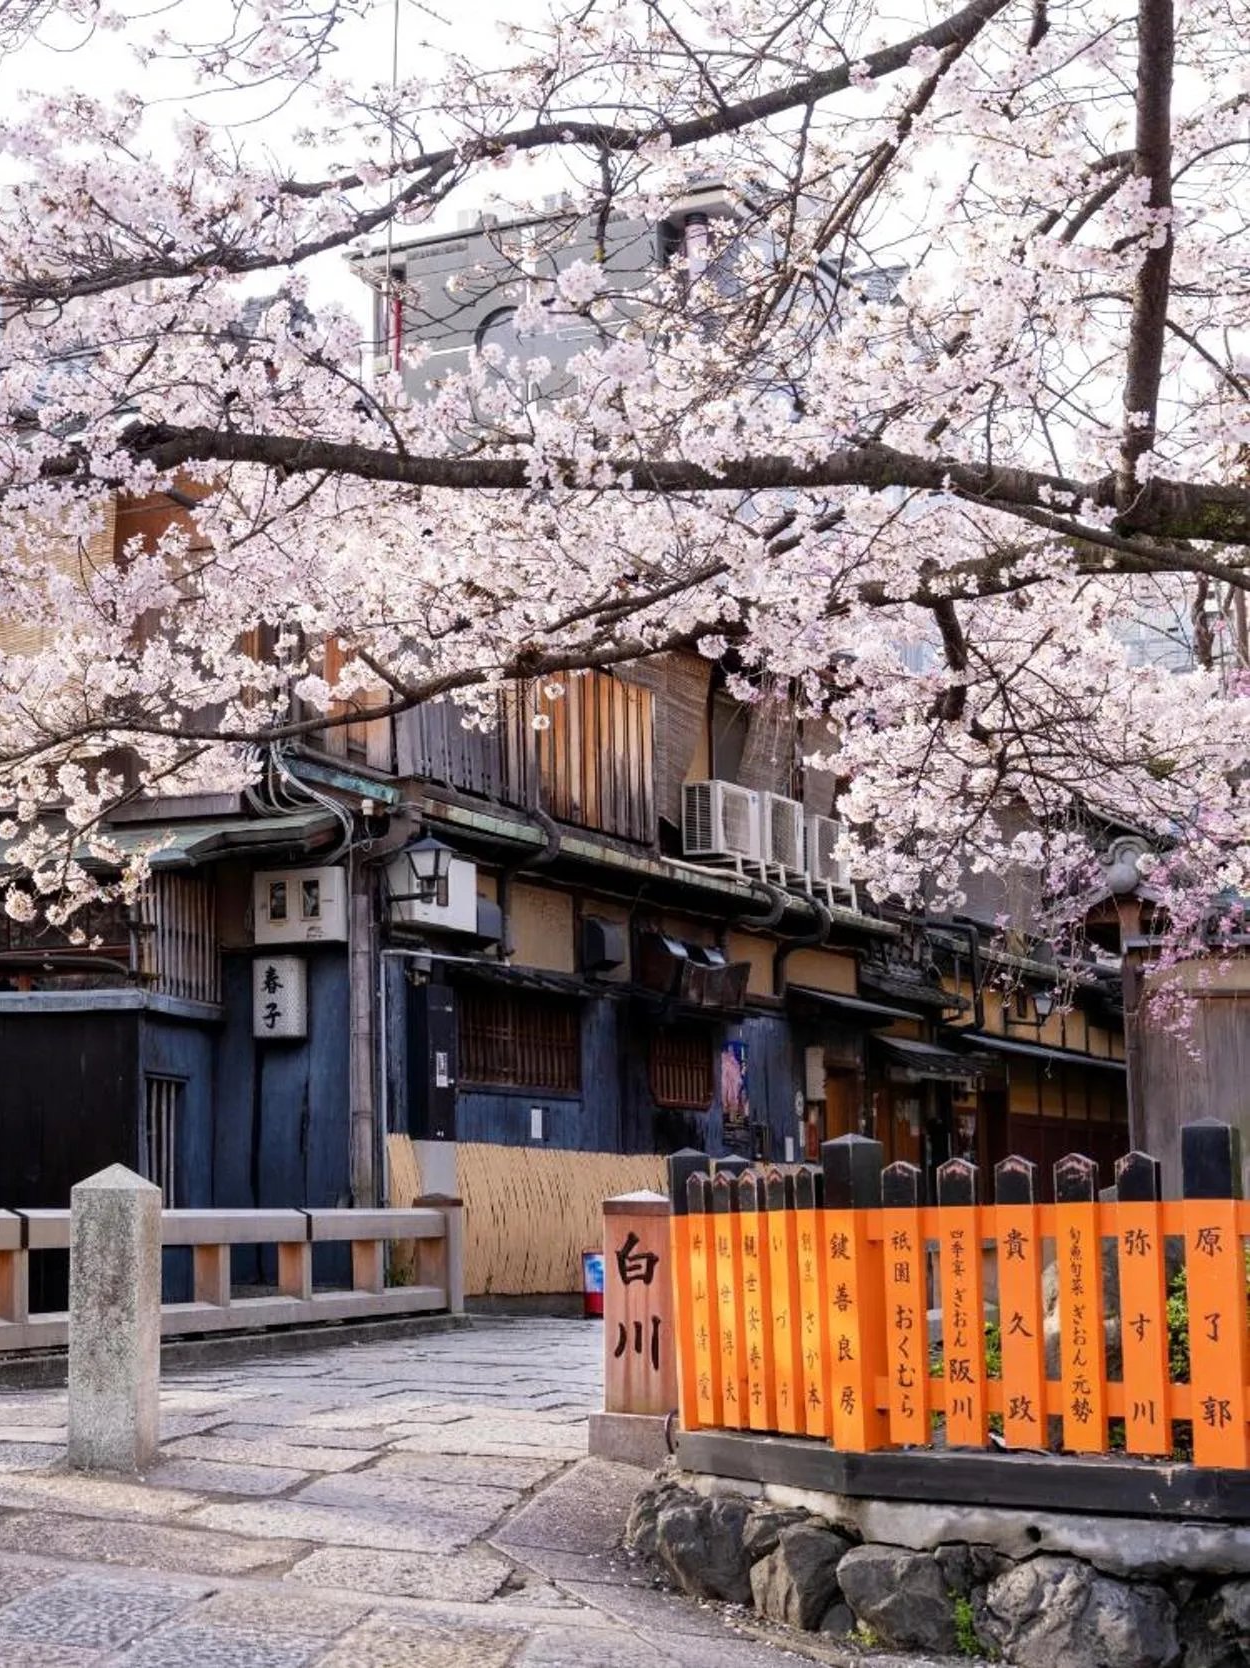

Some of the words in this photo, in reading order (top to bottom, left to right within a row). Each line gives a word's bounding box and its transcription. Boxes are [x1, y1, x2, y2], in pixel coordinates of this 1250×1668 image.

[261, 965, 284, 1029] 春子
[614, 1231, 660, 1371] 白川
[830, 1232, 855, 1415] 鍵善良房
[1003, 1228, 1036, 1422] 貴久政
[1124, 1228, 1152, 1425] 弥す川
[1195, 1226, 1232, 1429] 原了郭
